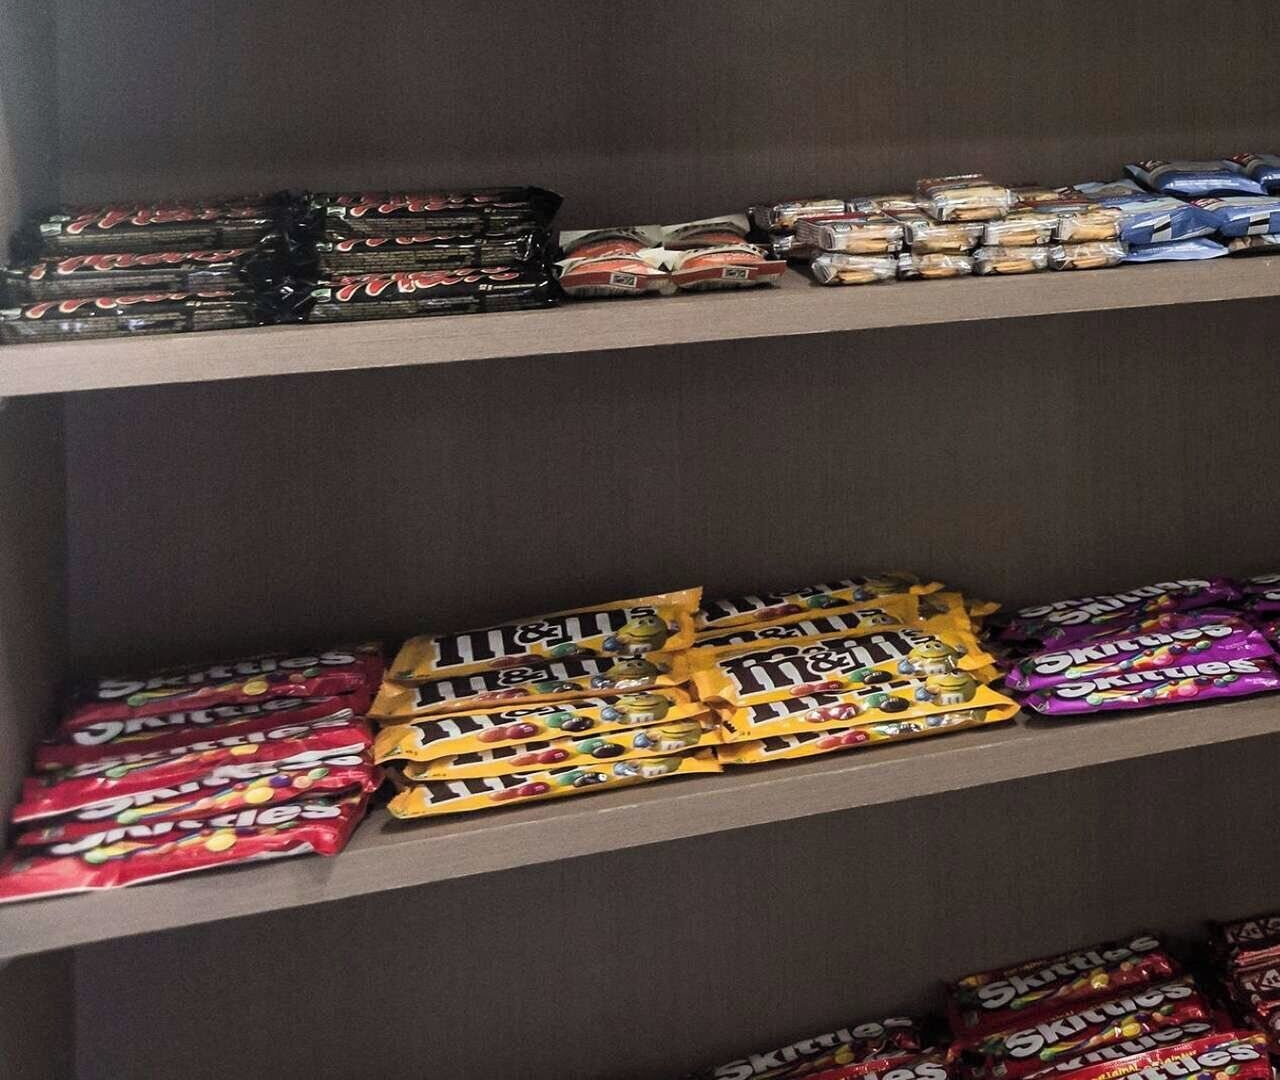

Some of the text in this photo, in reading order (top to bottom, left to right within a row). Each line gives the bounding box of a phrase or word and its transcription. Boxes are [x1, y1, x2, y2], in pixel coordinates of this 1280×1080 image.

[1034, 623, 1236, 675] Skittles
[1056, 658, 1262, 698] Skittles
[976, 935, 1160, 1010] Skittles
[1005, 983, 1193, 1059] Skittles
